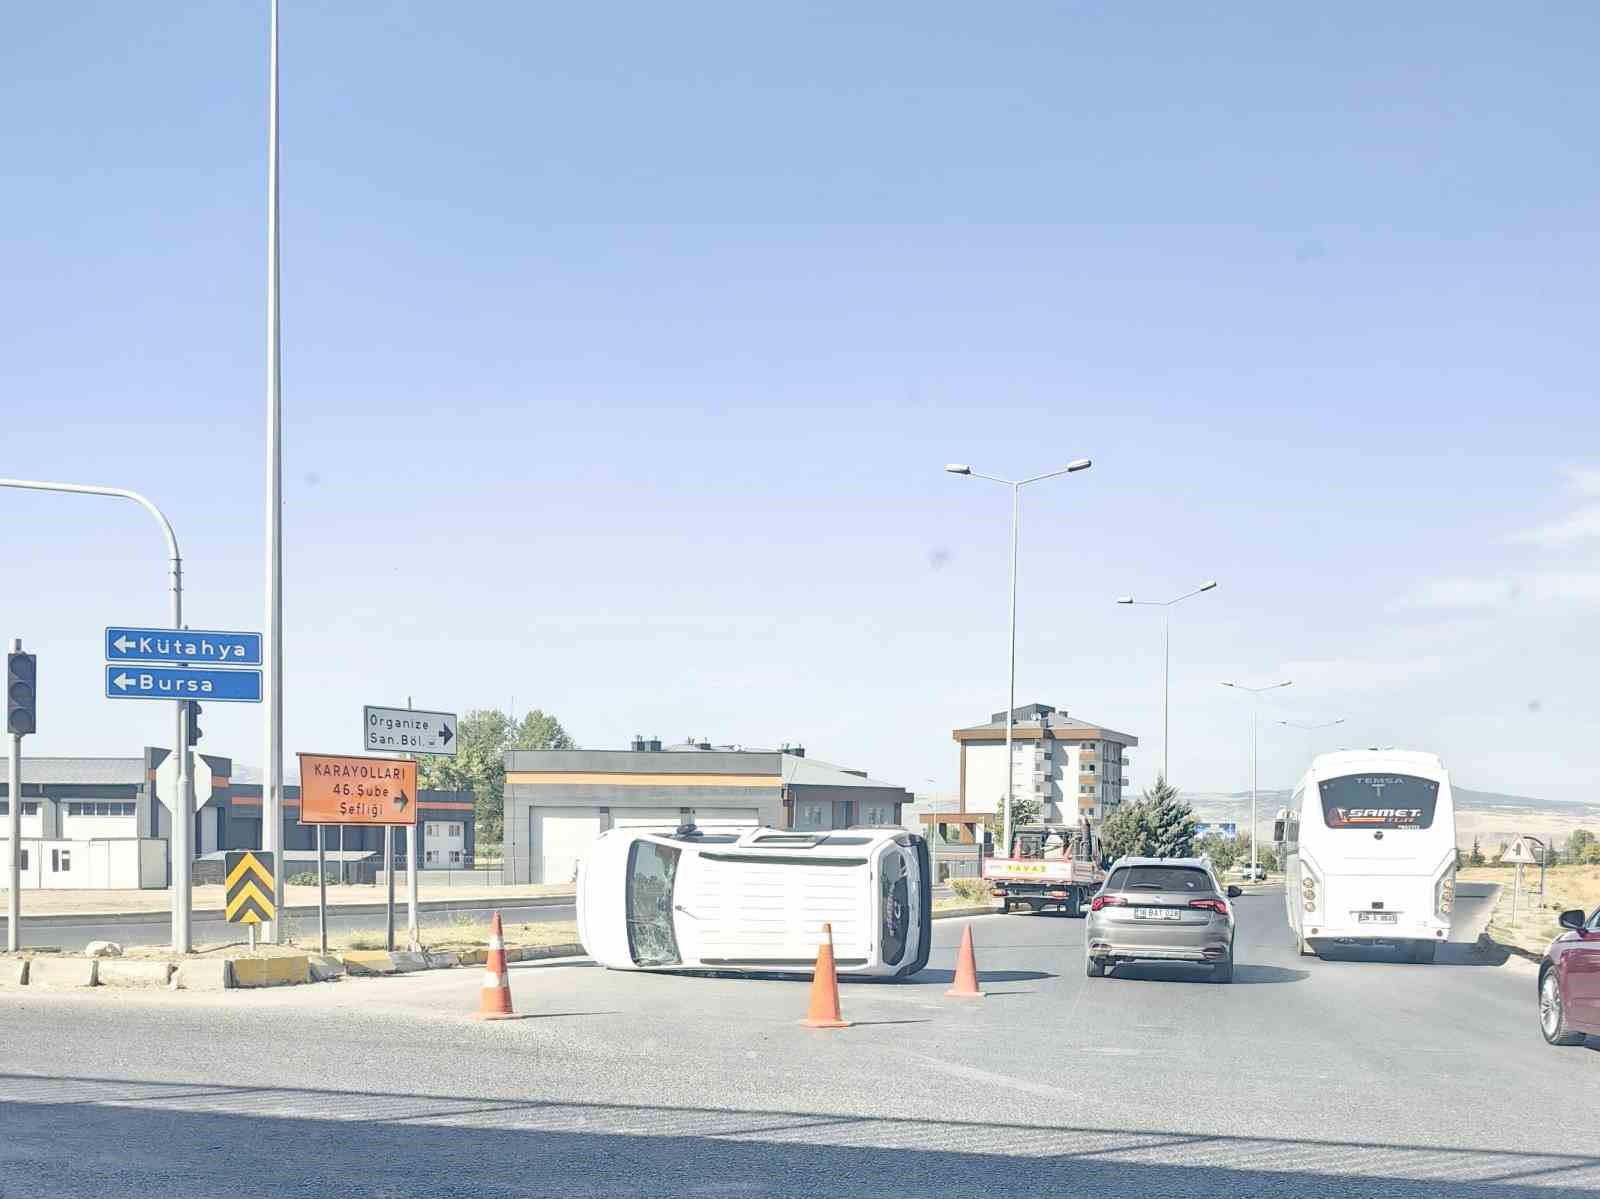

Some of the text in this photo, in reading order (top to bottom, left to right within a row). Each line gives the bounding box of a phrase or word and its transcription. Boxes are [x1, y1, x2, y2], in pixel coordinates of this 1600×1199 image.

[139, 637, 246, 660] Kütahya
[139, 673, 213, 692] Bursa
[369, 713, 429, 730] Organize
[313, 763, 405, 779] KARAYOLLARI
